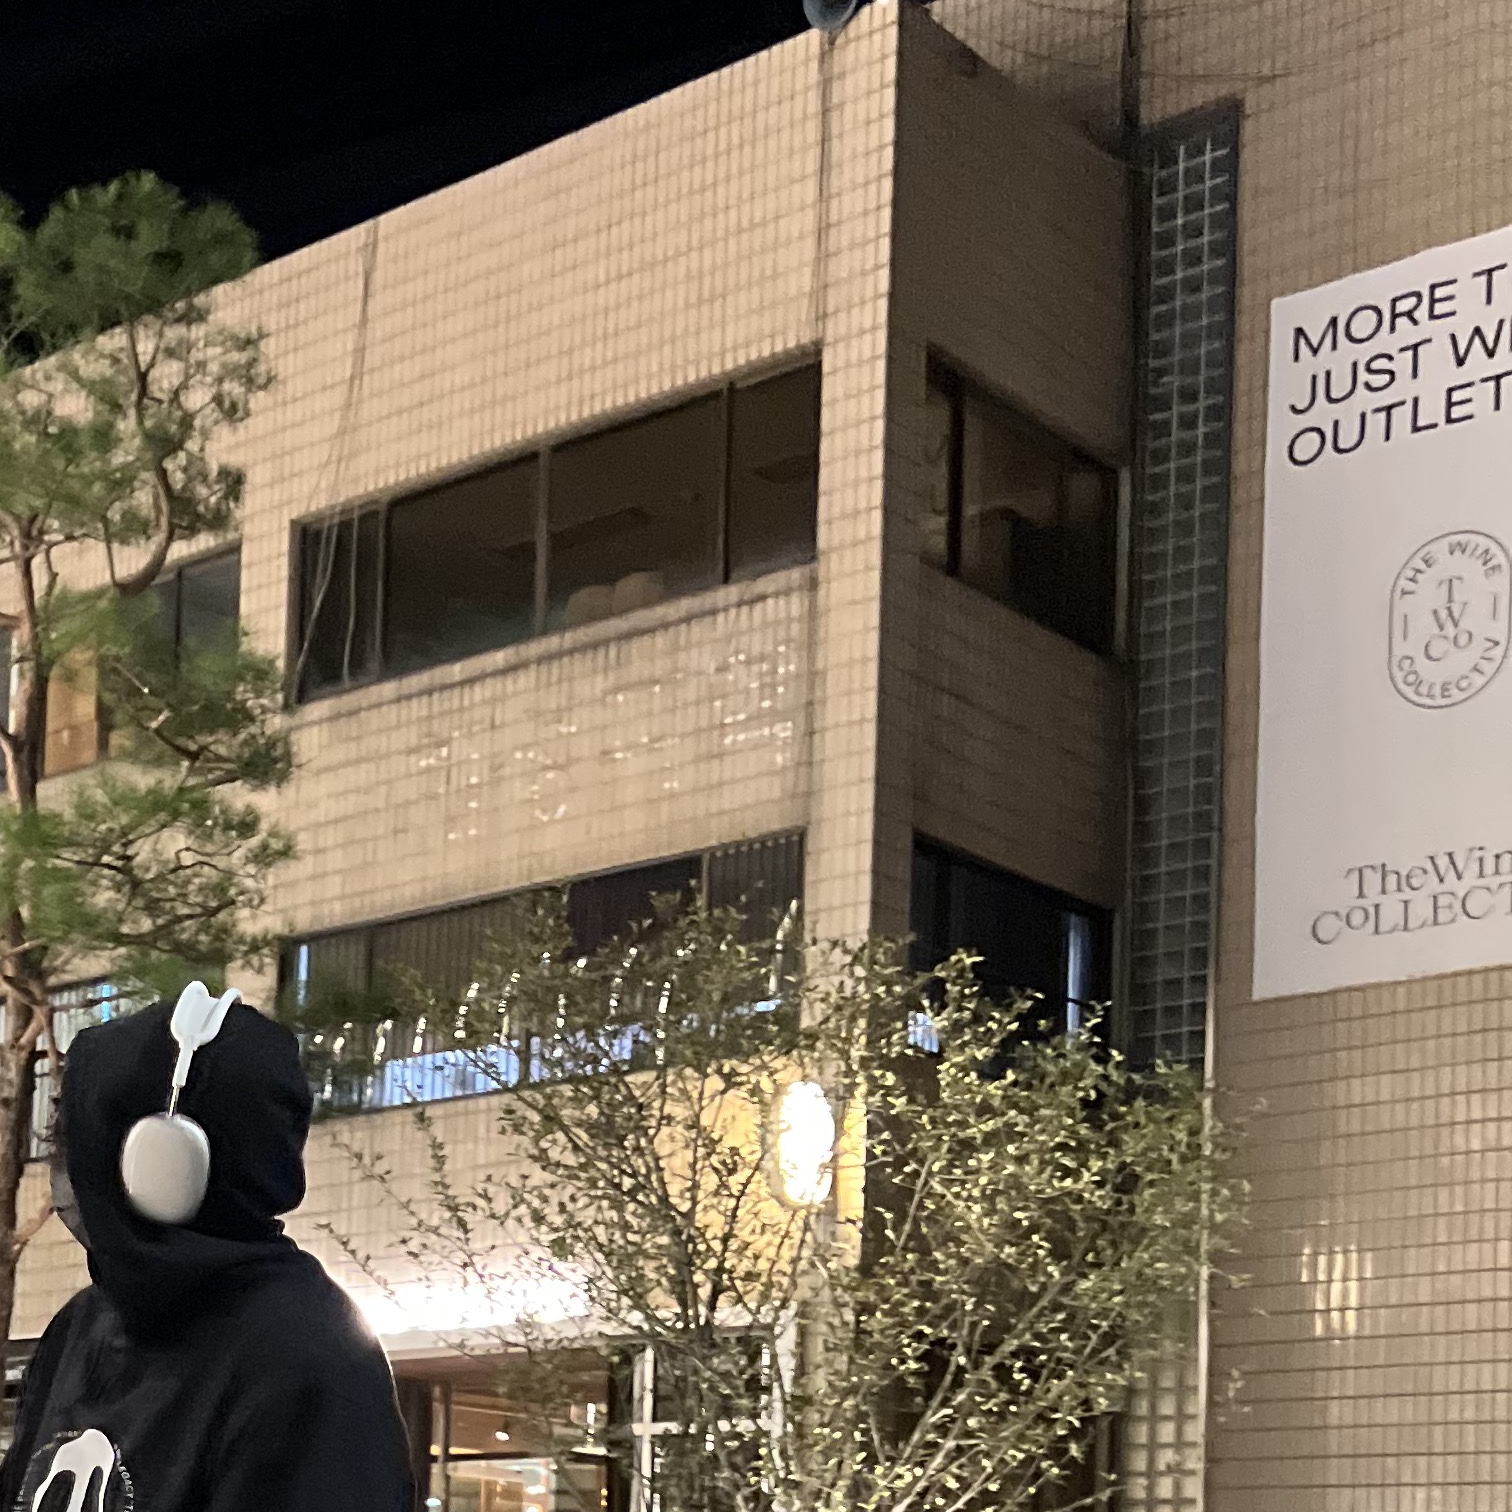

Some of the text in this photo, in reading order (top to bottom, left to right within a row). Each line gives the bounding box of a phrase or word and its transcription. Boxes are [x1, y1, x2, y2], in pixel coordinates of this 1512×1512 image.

[1292, 278, 1458, 363] MORE
[1289, 338, 1432, 415] JUST
[1287, 369, 1512, 467] OUTLET
[1399, 539, 1502, 600] THE WINE
